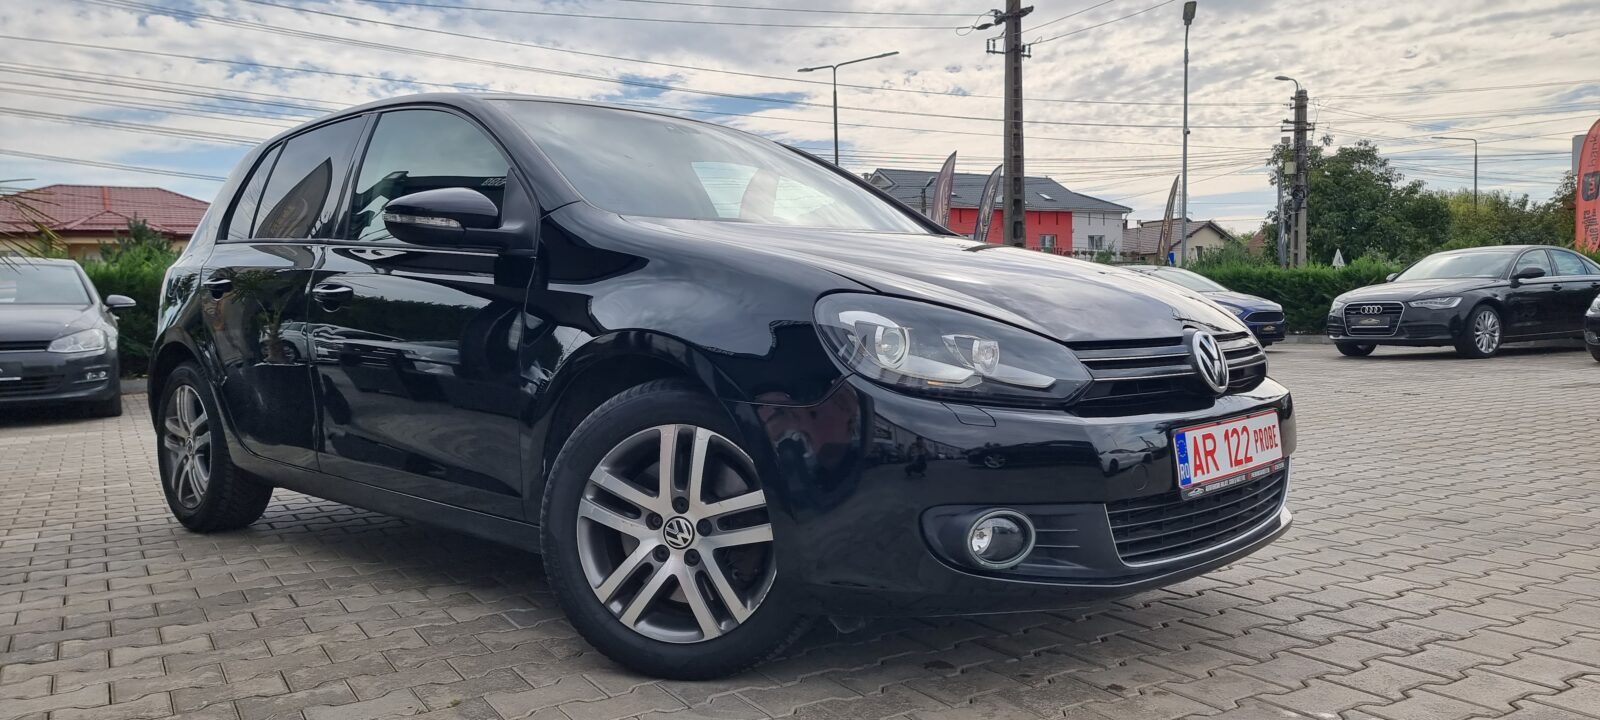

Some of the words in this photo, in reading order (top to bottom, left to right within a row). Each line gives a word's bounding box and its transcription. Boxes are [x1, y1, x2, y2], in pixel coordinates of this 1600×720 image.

[1193, 432, 1219, 477] AR
[1224, 425, 1253, 468] 122
[1253, 425, 1278, 453] PROBE
[1180, 463, 1190, 480] RO
